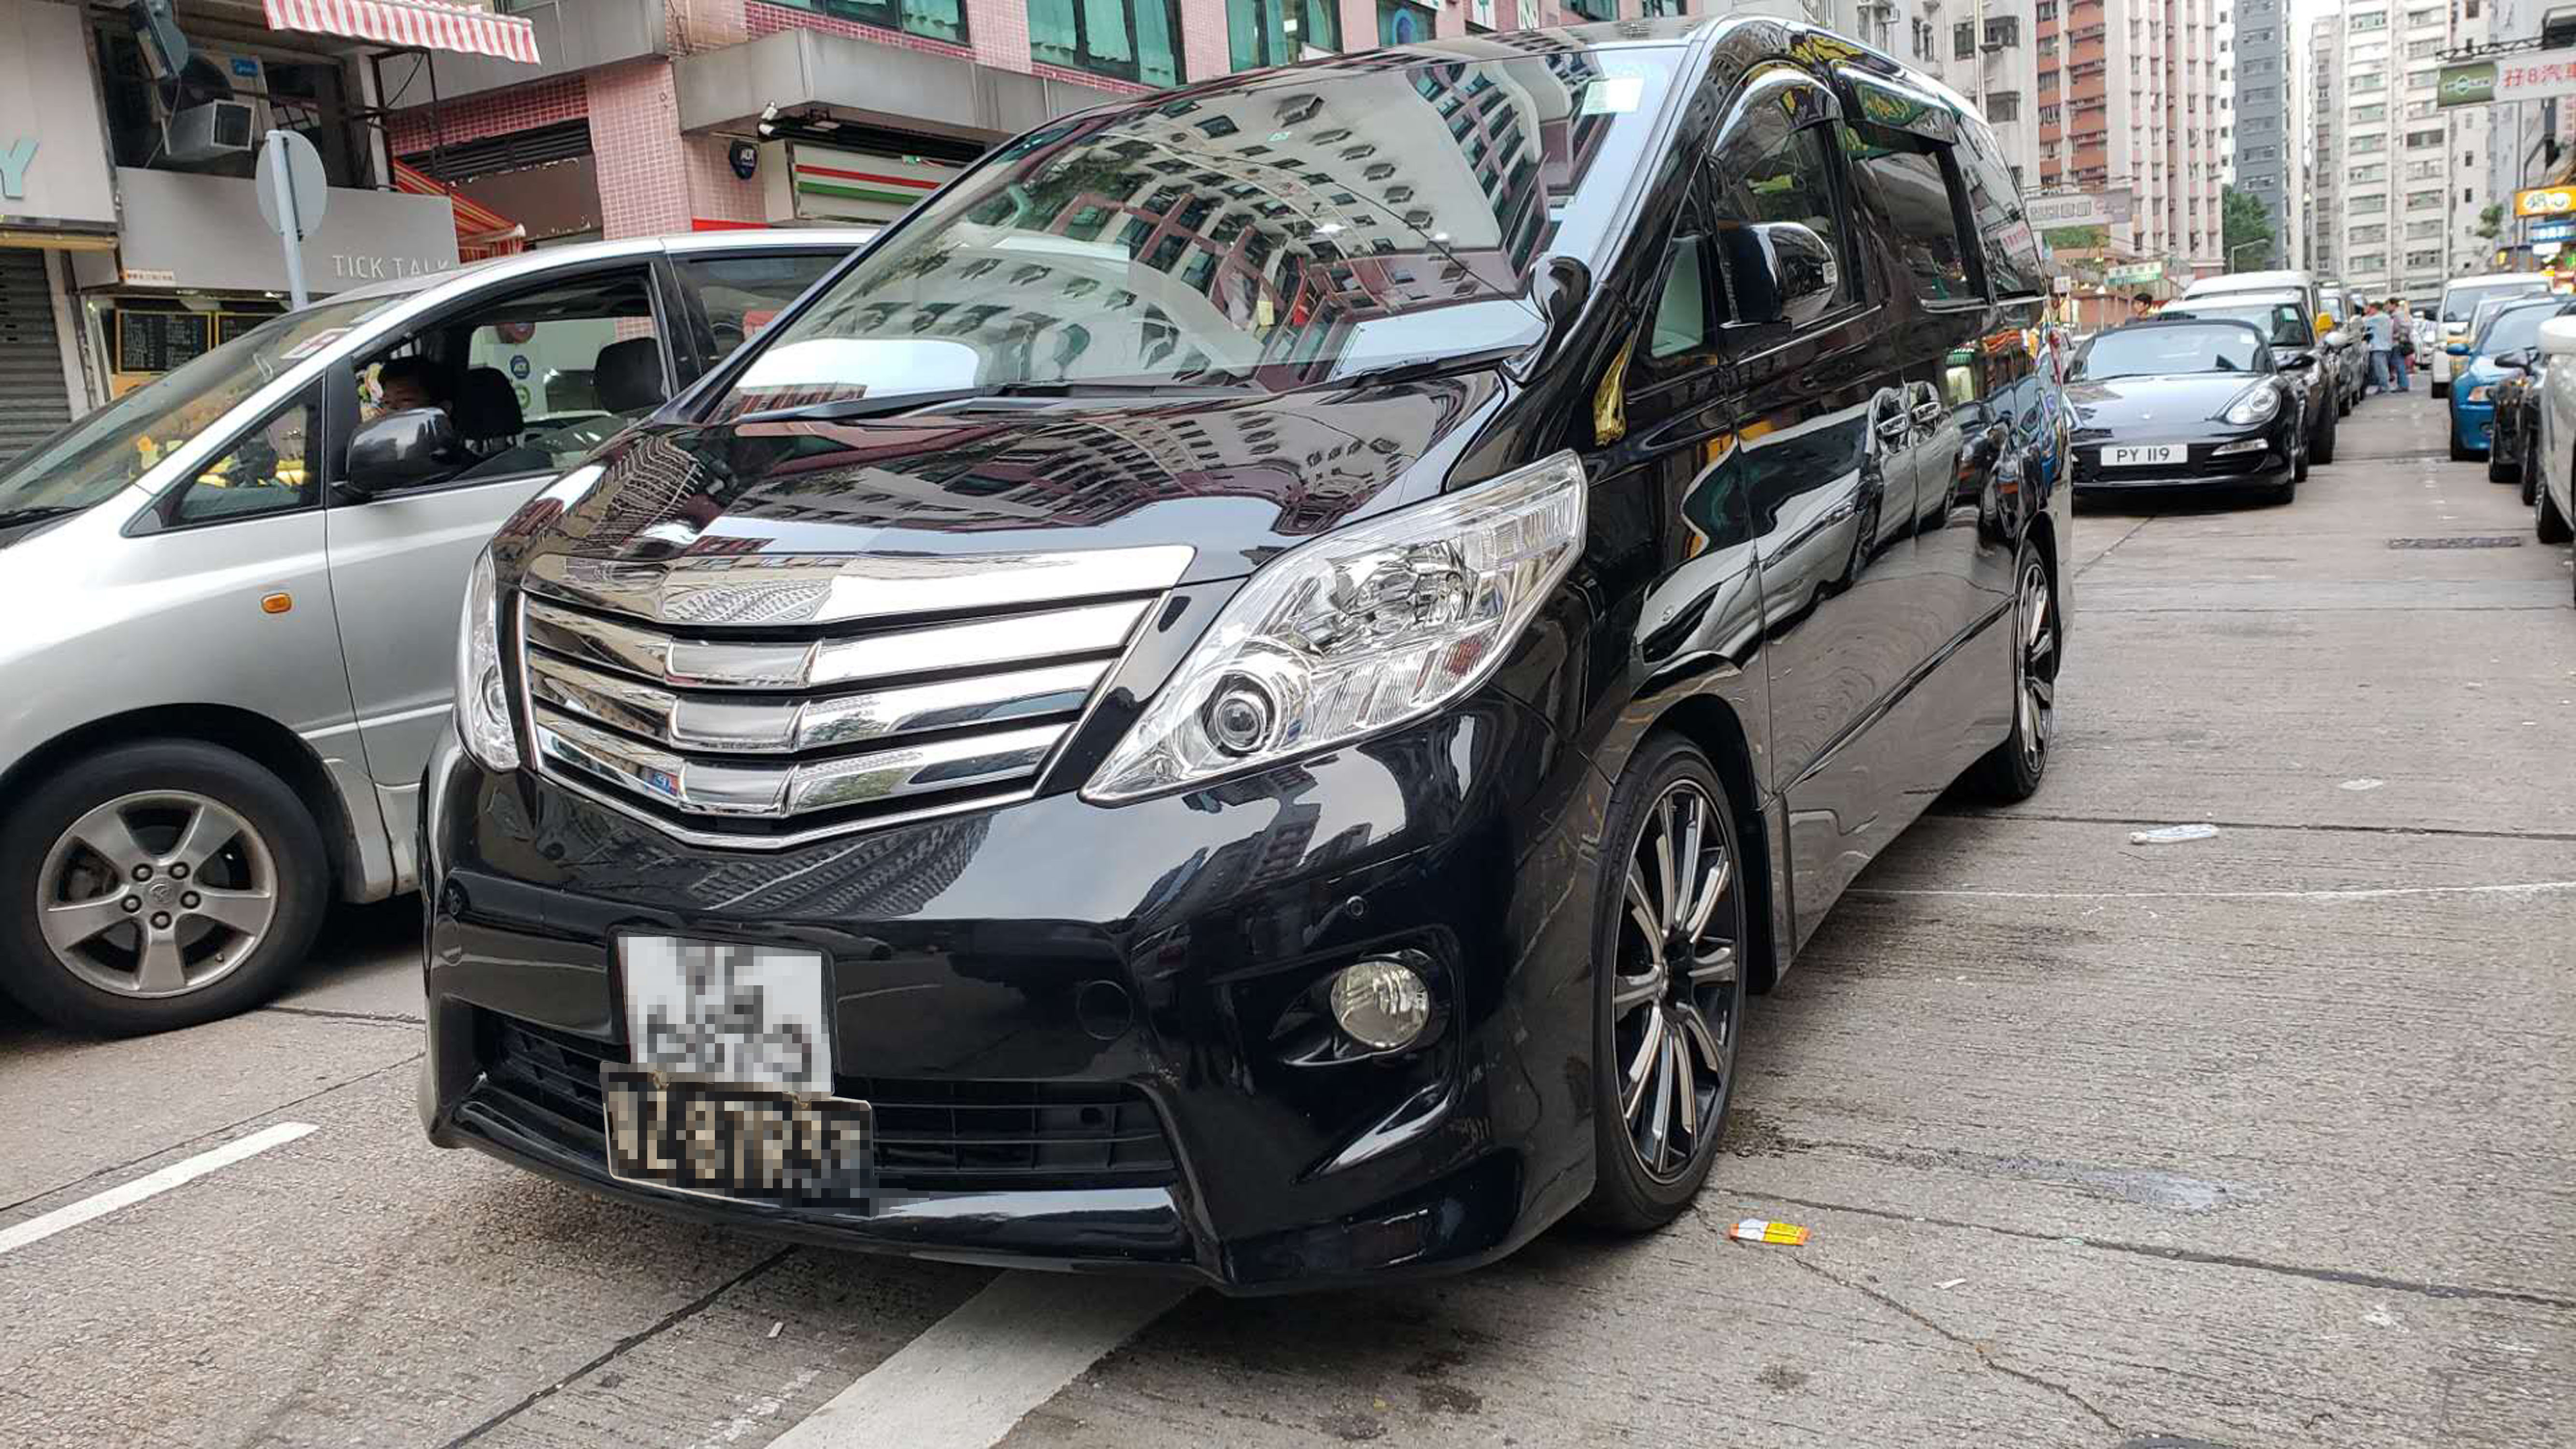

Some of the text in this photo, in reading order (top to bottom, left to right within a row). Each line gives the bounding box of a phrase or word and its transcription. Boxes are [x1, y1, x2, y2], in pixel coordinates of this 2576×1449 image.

[332, 255, 385, 279] TICK
[2117, 447, 2170, 462] PY 119
